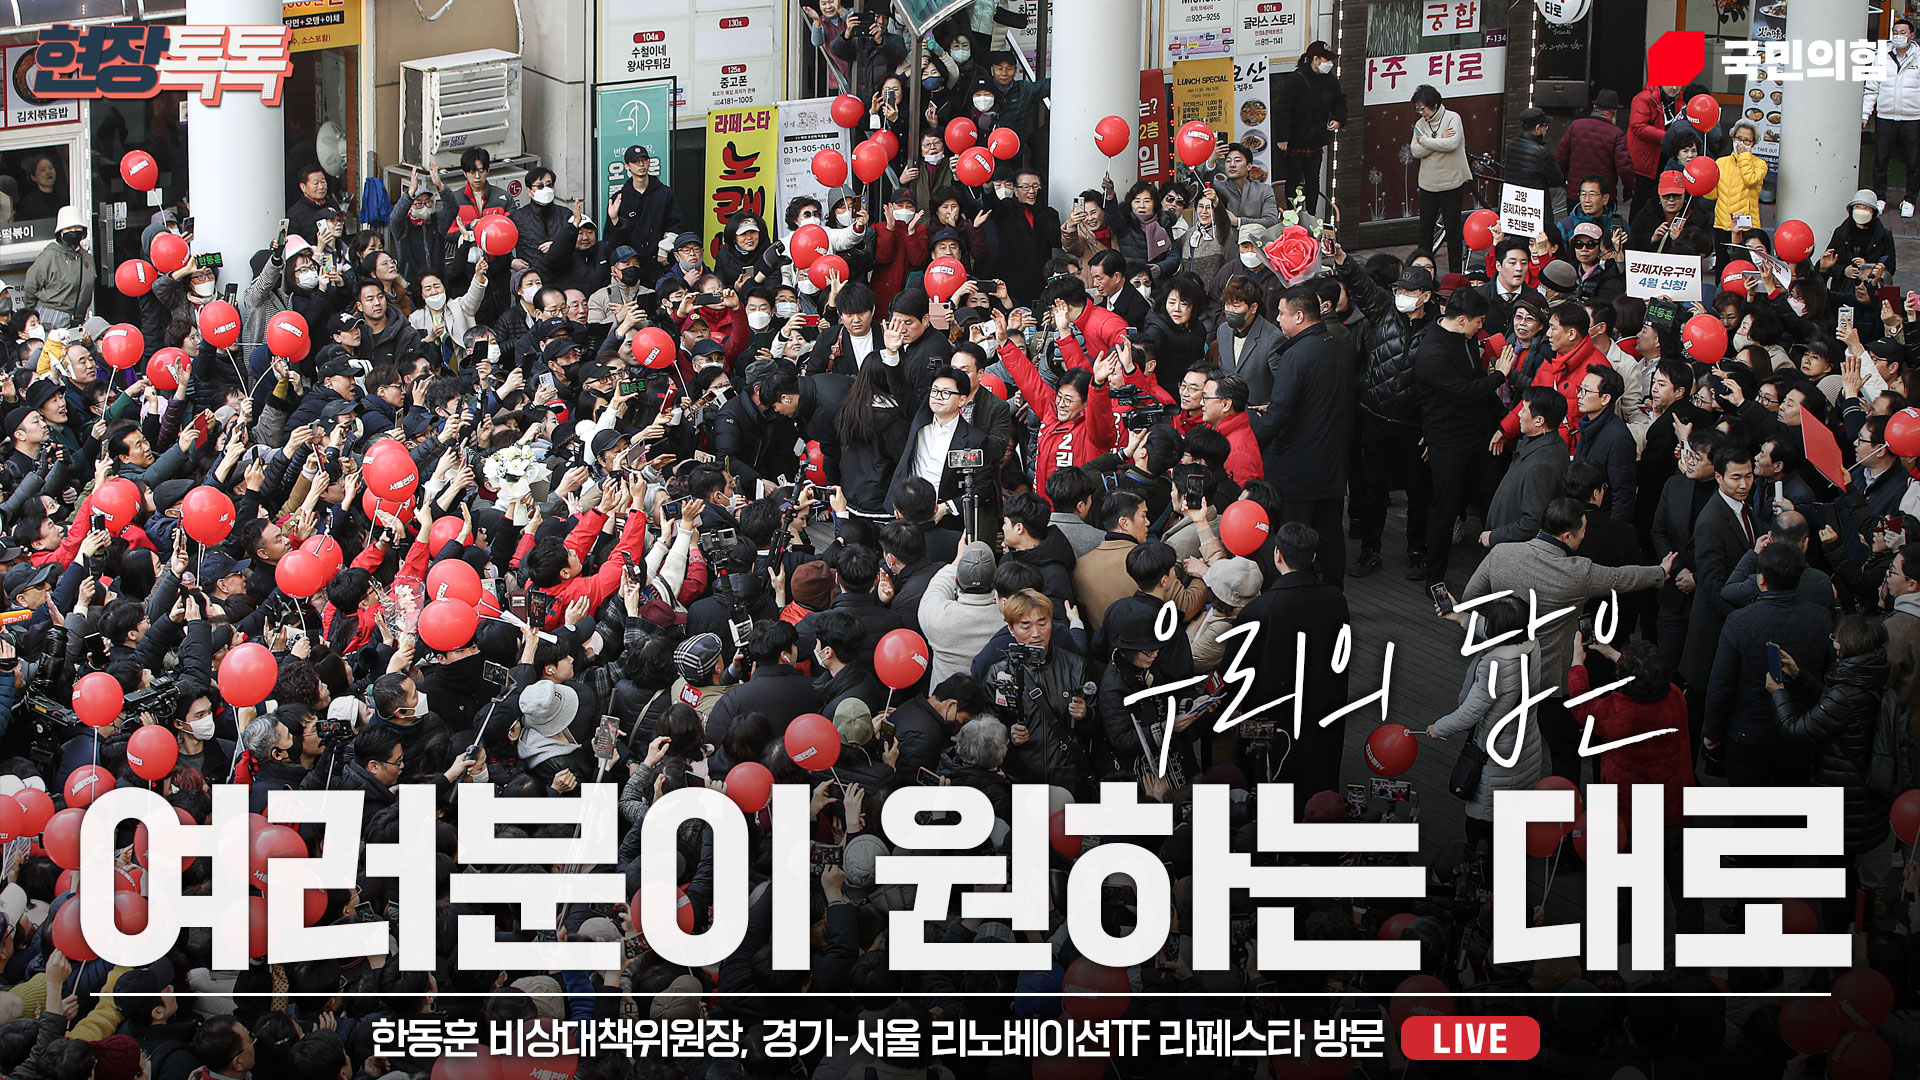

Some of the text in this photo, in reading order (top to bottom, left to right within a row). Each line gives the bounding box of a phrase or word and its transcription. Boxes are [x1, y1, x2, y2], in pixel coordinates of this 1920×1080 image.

[1191, 12, 1221, 22] 920-9255
[1426, 1, 1477, 31] 궁합
[1544, 1, 1562, 18] 타로
[1243, 13, 1296, 30] 글라스 스토리
[1486, 34, 1507, 43] F-134
[631, 44, 667, 59] 수철이네
[626, 57, 671, 73] 왕새우튀김
[1428, 52, 1484, 85] 타로
[719, 75, 748, 90] 중고폰
[1177, 75, 1229, 86] LUNCH SPECIAL
[16, 106, 69, 123] 김치볶음밥
[714, 110, 771, 134] 라페스타
[783, 143, 841, 155] 031-905-0610
[709, 140, 766, 261] 노래
[1514, 190, 1528, 203] 고양
[1502, 202, 1541, 219] 경제자유구역
[1507, 218, 1535, 233] 추진본부
[1629, 262, 1697, 279] 경제자유구역
[1638, 277, 1688, 291] 4월 신청!
